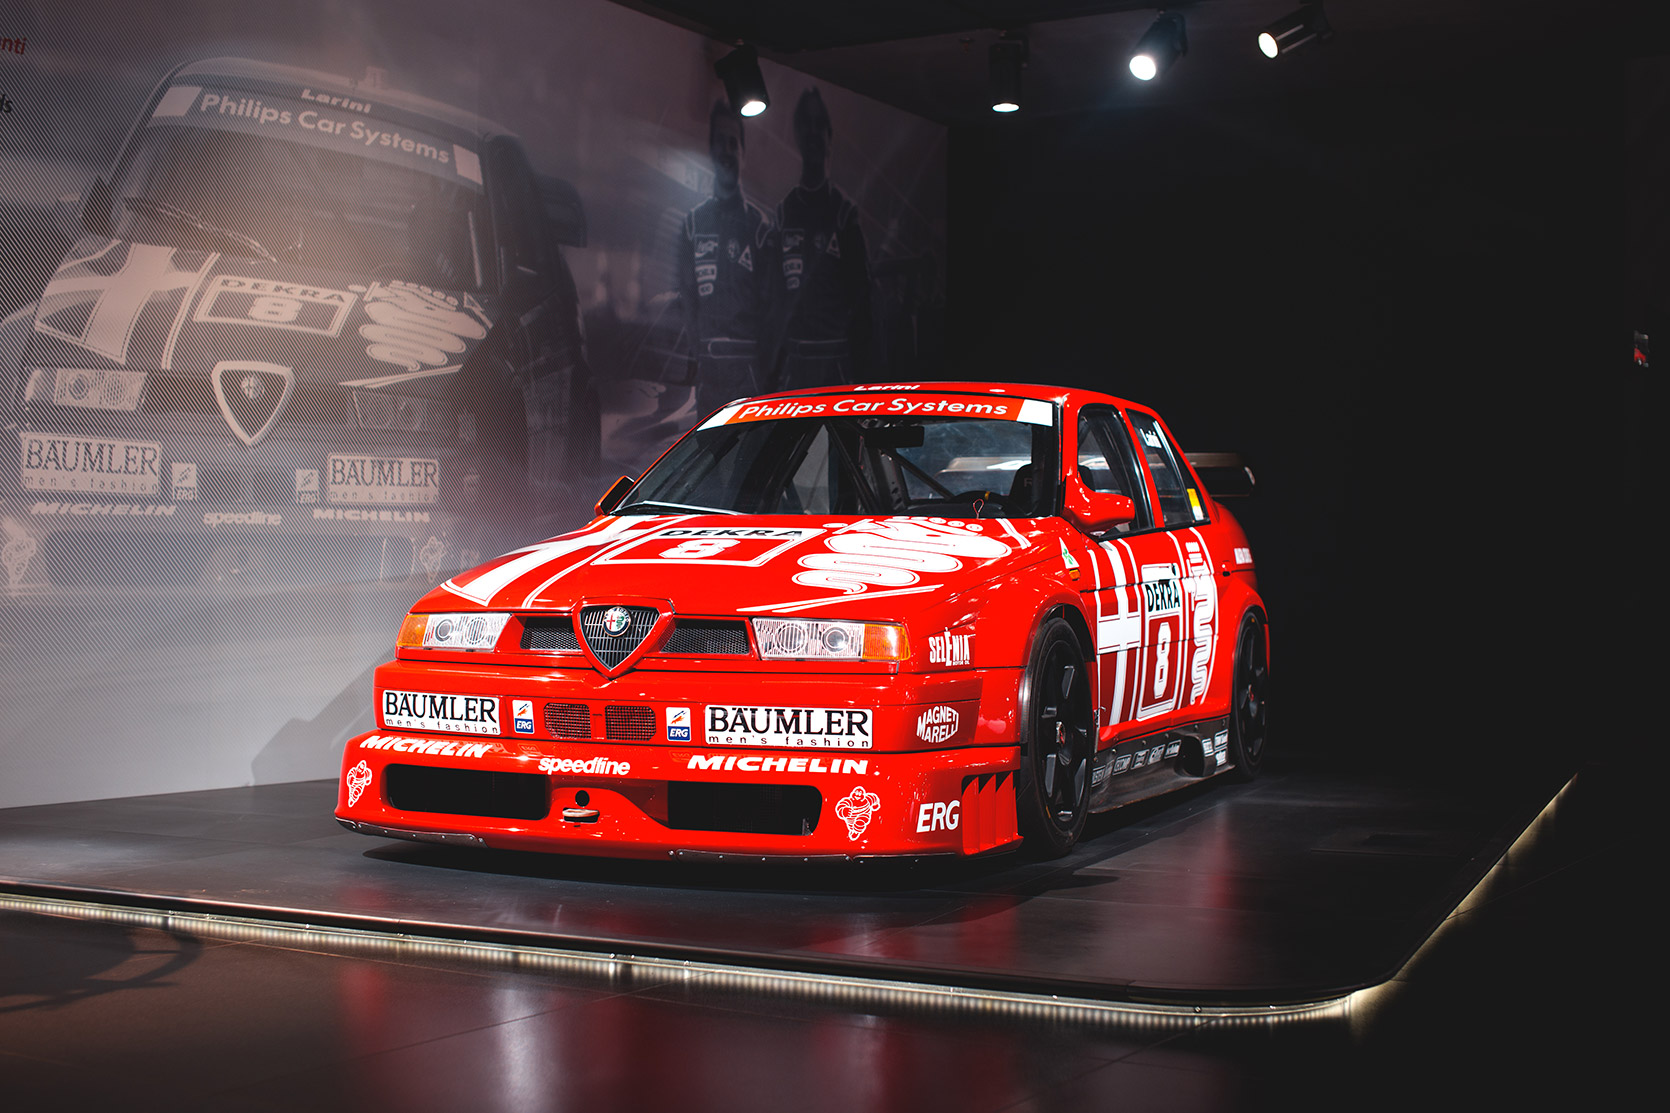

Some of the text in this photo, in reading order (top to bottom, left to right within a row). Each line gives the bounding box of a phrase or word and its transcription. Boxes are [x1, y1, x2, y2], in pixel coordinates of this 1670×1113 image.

[301, 88, 371, 114] Larini
[200, 93, 450, 163] Philips Car Systems
[220, 279, 345, 302] DEKRA
[249, 296, 302, 323] 8
[738, 397, 1009, 418] Philips Car Systems
[30, 502, 177, 516] MICHELIN
[313, 508, 430, 522] MICHELIN
[659, 529, 803, 537] DEKRA
[658, 538, 741, 559] 8
[1145, 579, 1180, 613] DEKRA
[1153, 621, 1171, 700] 8
[385, 691, 498, 723] BÄUMLER
[386, 718, 499, 735] men's fashion
[516, 720, 532, 731] ERG
[708, 706, 870, 737] BÄUMLER
[669, 728, 689, 738] ERG
[708, 735, 870, 748] men's fashion
[359, 736, 494, 758] MICHELIN
[538, 757, 631, 776] speedline
[687, 755, 869, 775] MICHELIN
[916, 800, 961, 833] ERG
